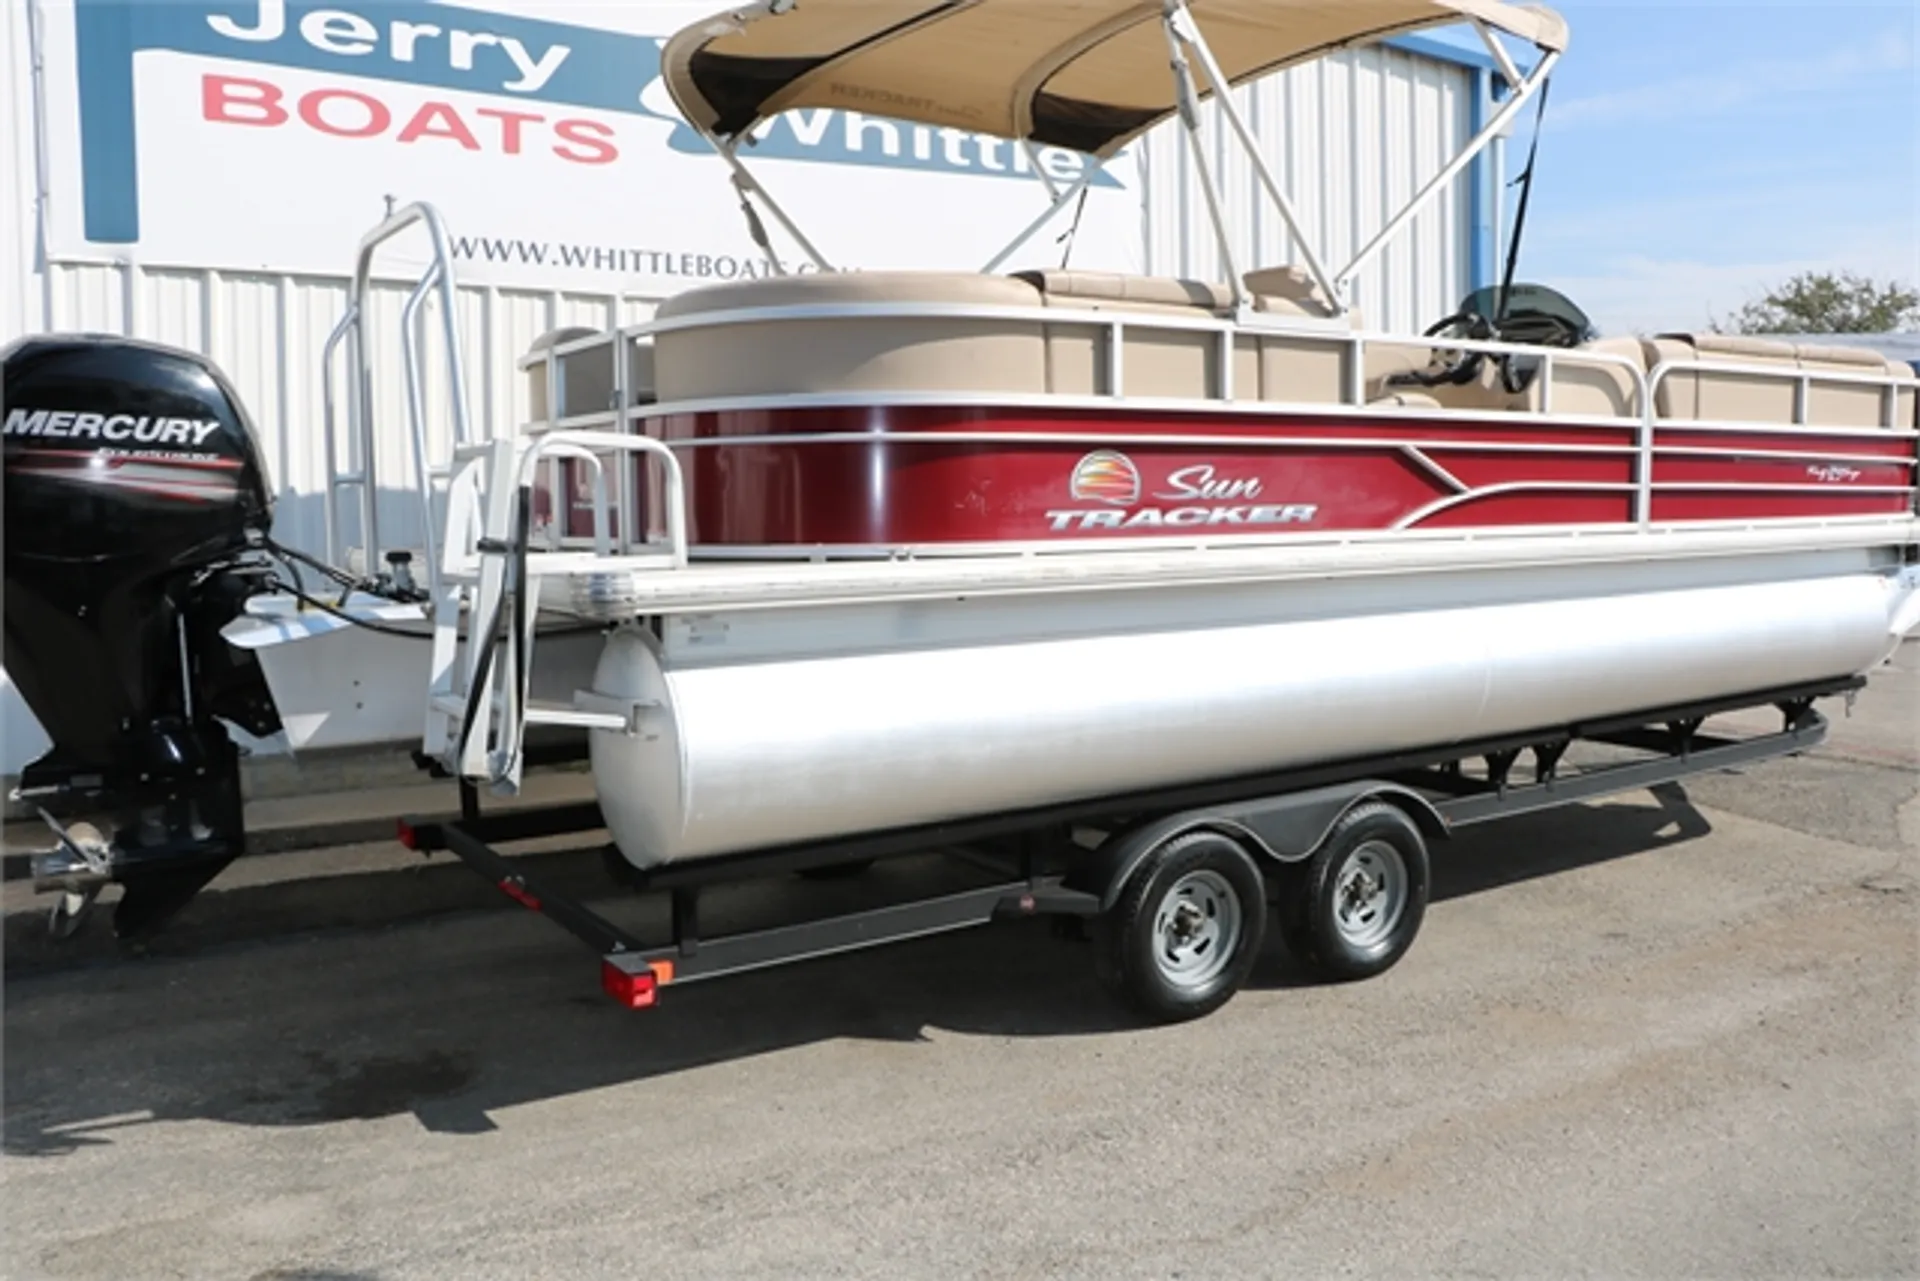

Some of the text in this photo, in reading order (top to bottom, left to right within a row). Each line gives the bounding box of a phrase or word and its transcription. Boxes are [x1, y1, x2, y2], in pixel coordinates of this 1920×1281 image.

[206, 0, 571, 92] Jerry
[202, 73, 619, 165] BOATS
[3, 408, 220, 446] MERCURY
[1152, 464, 1263, 501] Sun
[1044, 504, 1319, 531] TRACKER
